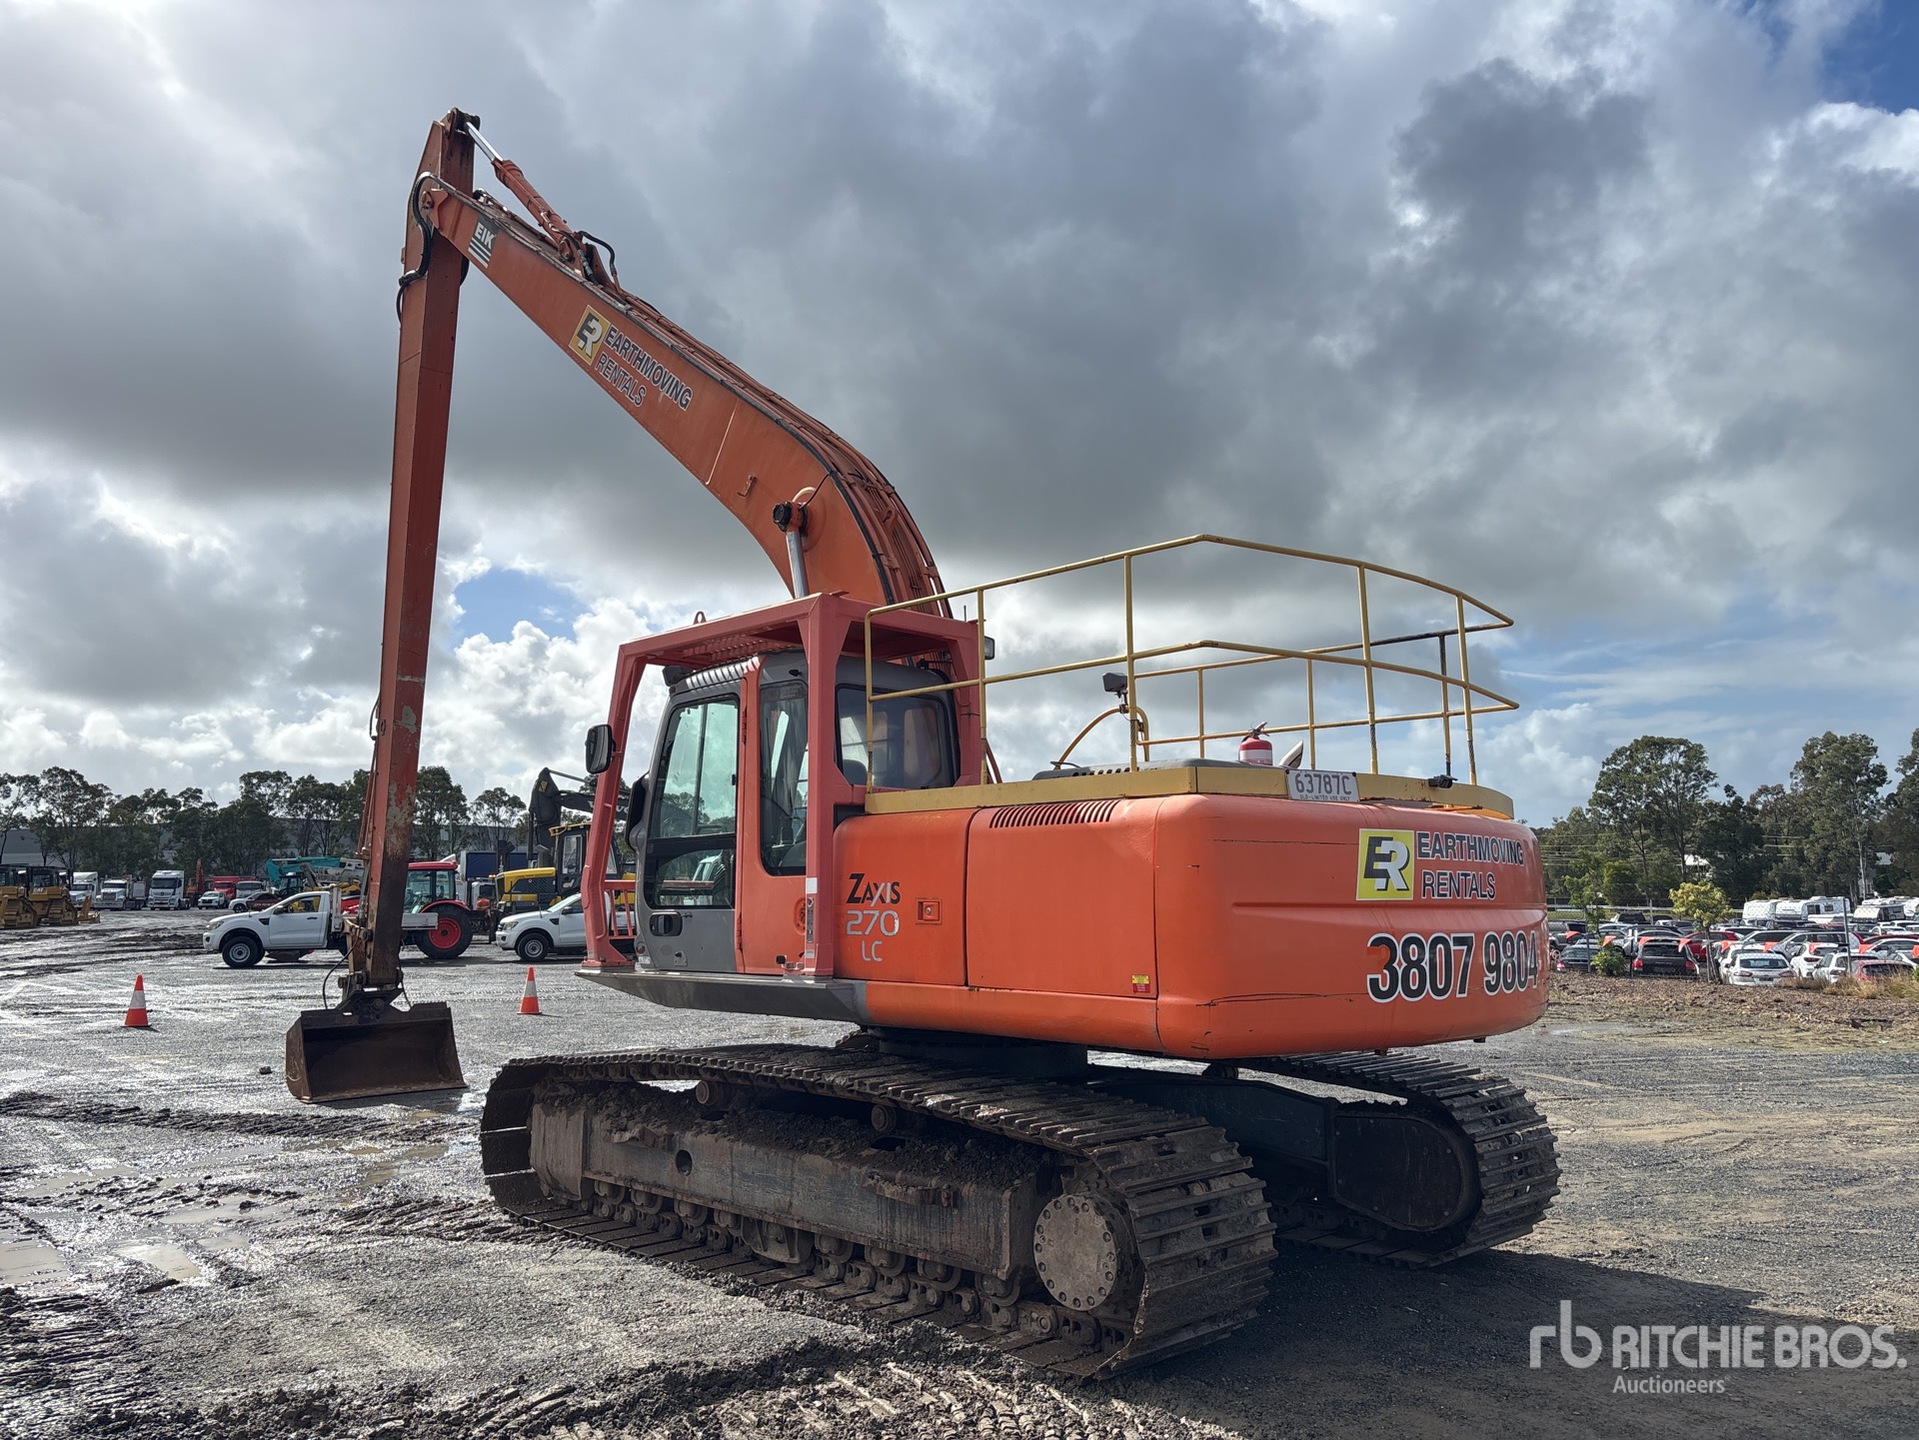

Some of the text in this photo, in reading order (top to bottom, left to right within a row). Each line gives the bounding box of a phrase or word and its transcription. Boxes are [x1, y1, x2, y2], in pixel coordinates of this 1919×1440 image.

[474, 222, 497, 249] EIK
[595, 351, 647, 407] RENTALS
[603, 325, 693, 411] EARTHMOVING
[1294, 773, 1352, 795] 63787C
[1416, 831, 1524, 866] EARTHMOVING
[1421, 869, 1496, 900] RENTALS
[846, 910, 900, 936] 270
[862, 940, 883, 962] LC
[1367, 930, 1538, 1003] 3807 9804
